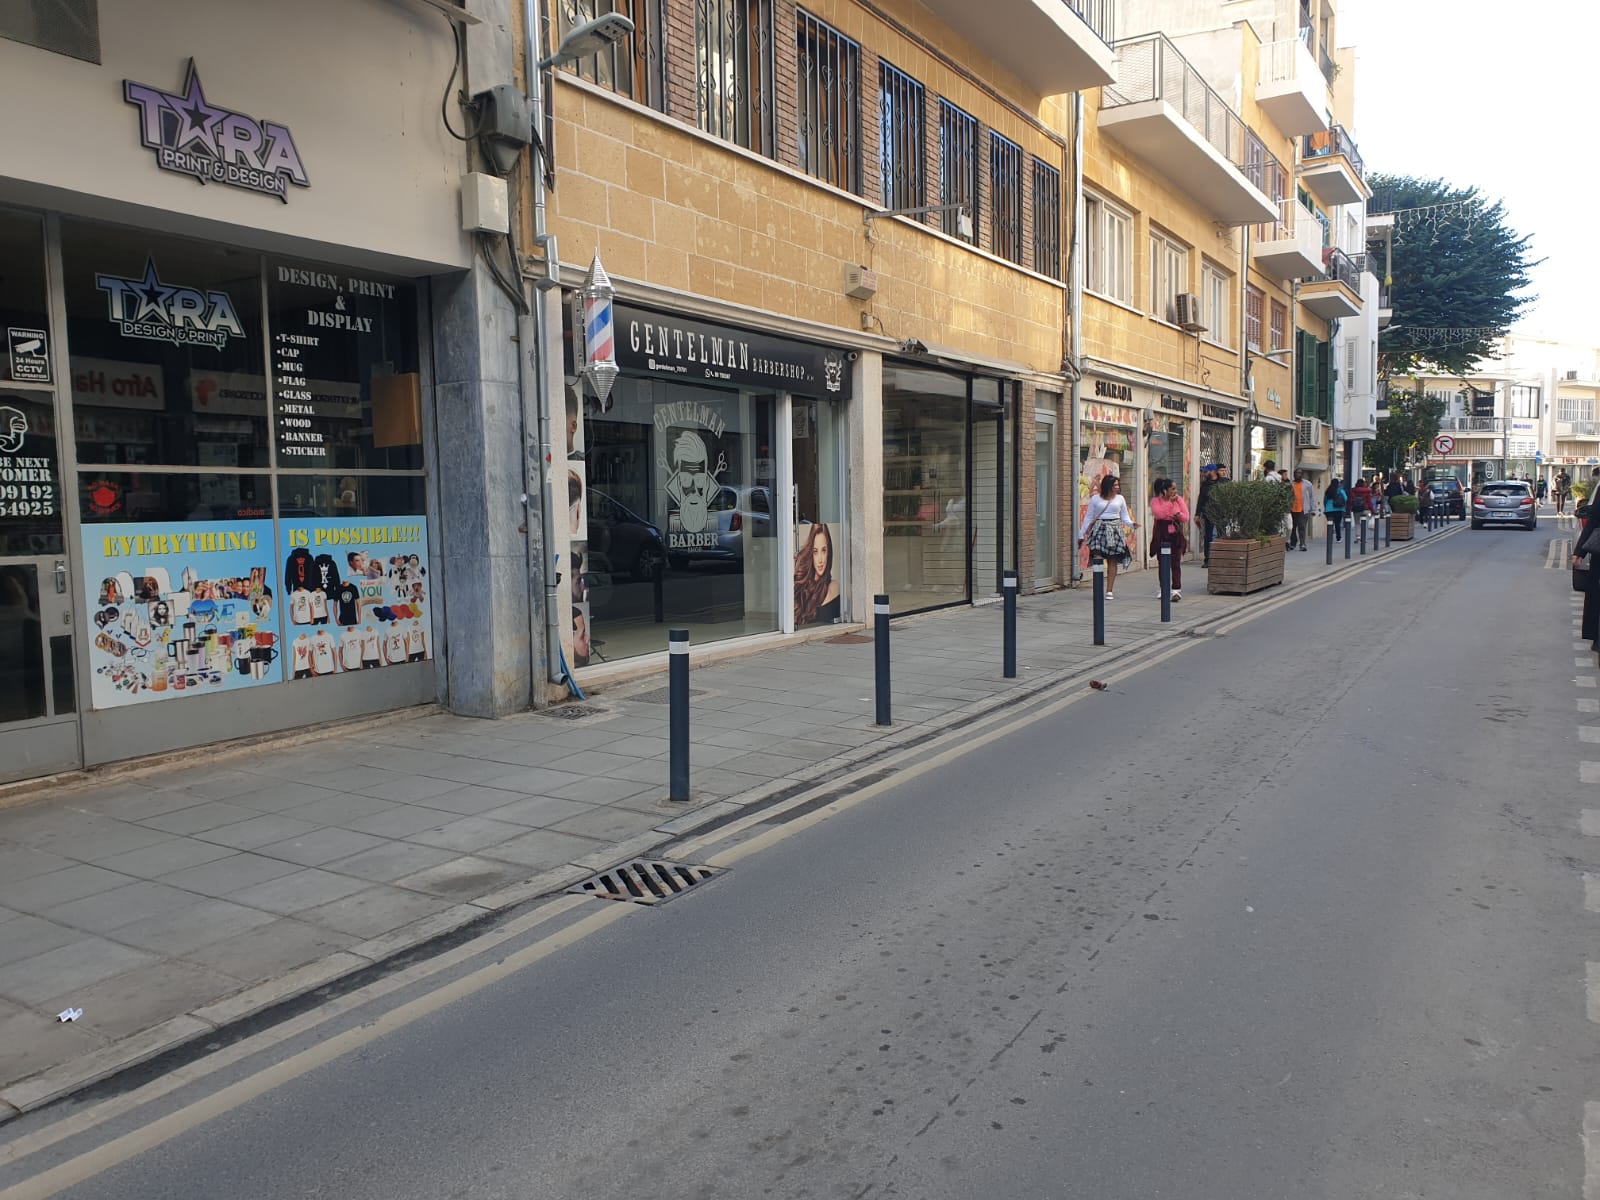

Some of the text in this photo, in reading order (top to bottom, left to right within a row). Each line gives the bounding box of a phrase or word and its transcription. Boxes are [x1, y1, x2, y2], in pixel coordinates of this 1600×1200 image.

[163, 149, 285, 191] PRINT & DESIGN
[278, 266, 396, 300] DESIGN, PRINT
[335, 295, 347, 311] &
[307, 310, 373, 334] DISPLAY
[11, 330, 44, 340] WARNING
[124, 322, 224, 344] DESIGN & PRINT
[281, 348, 300, 358] CAP
[630, 320, 806, 381] GENTELMAN BARBERSHOP
[16, 364, 44, 374] CCTV
[282, 362, 303, 373] MUG
[282, 376, 306, 387] FLAG
[283, 390, 312, 401] GLASS
[1095, 380, 1132, 402] SHARADA
[284, 404, 315, 415] METAL
[284, 418, 312, 428] WOOD
[654, 400, 726, 440] GENTELMAN
[285, 432, 324, 442] BANNER
[285, 446, 326, 456] STICKER
[16, 457, 50, 468] NEXT
[288, 525, 422, 548] IS POSSIBLE!!!
[668, 532, 720, 548] BARBER
[102, 530, 258, 558] EVERYTHING
[361, 586, 382, 598] YOU
